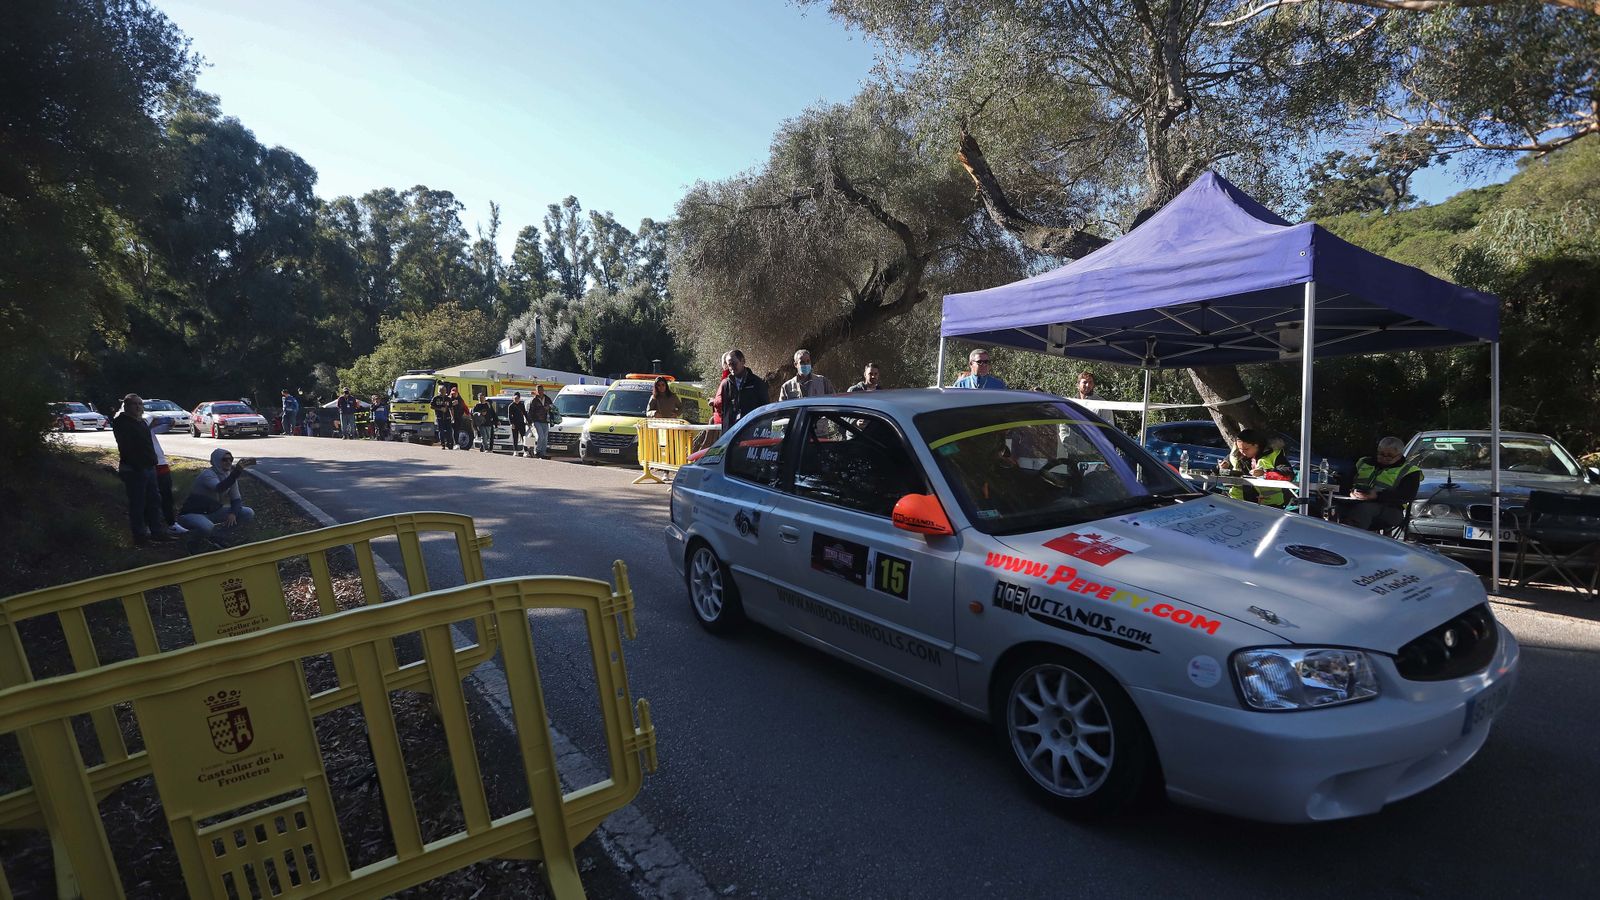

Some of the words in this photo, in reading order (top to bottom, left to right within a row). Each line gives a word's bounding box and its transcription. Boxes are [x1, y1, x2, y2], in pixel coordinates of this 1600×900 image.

[760, 447, 779, 462] Mera
[881, 558, 906, 594] 15
[216, 621, 251, 635] Castellar
[251, 618, 262, 628] de
[261, 615, 270, 624] la
[776, 587, 942, 666] WWW.MIBODAENROLLS.COM
[197, 758, 254, 783] Castellar
[256, 753, 271, 766] de
[273, 750, 285, 761] la
[217, 765, 271, 788] Frontera
